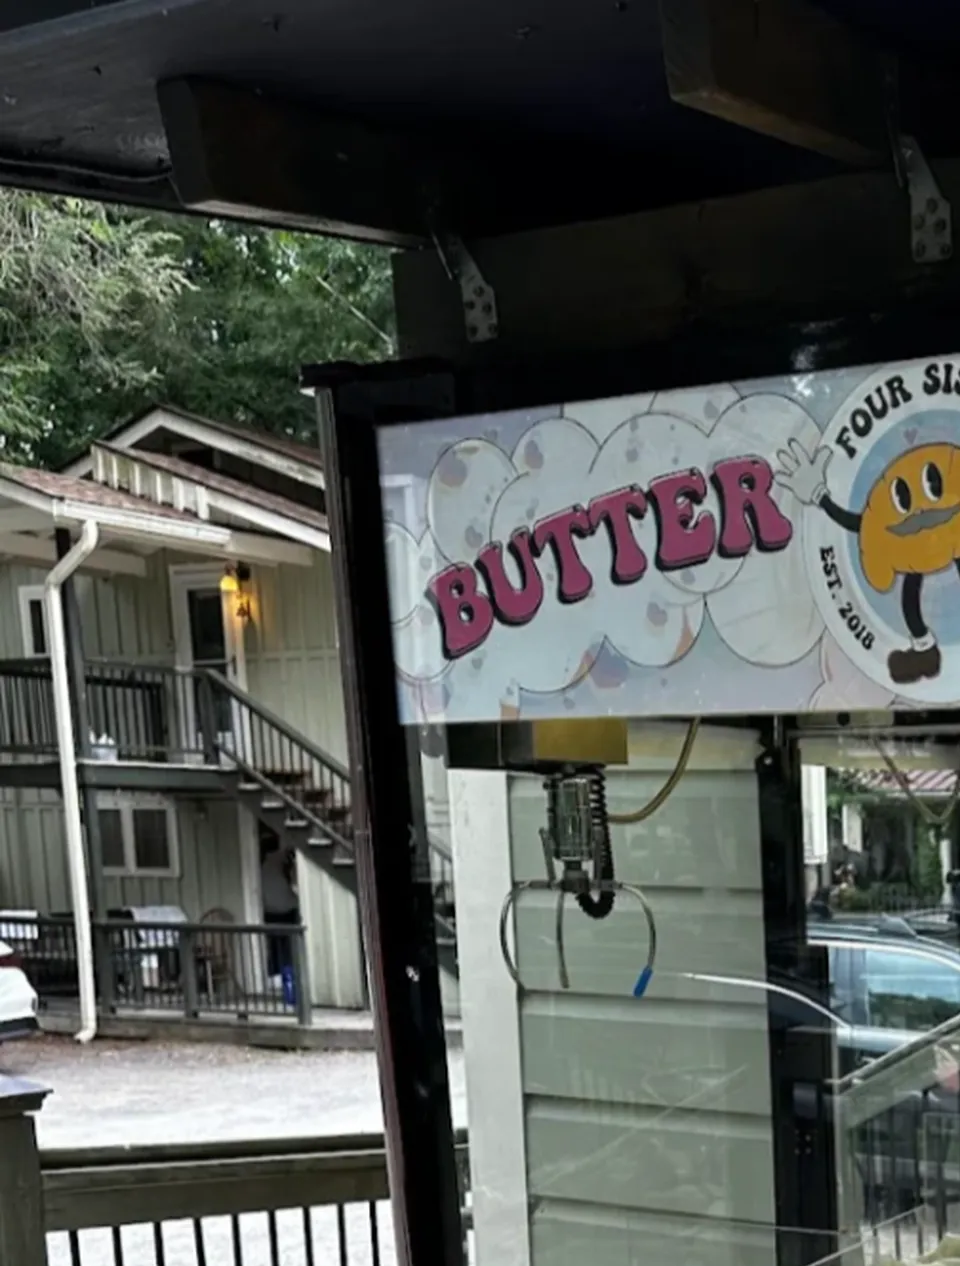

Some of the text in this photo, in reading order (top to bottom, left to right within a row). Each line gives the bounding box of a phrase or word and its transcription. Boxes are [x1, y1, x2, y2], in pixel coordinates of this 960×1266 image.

[835, 375, 912, 459] FOUR
[425, 453, 793, 660] BUTTER
[819, 546, 876, 651] EST. 2018
